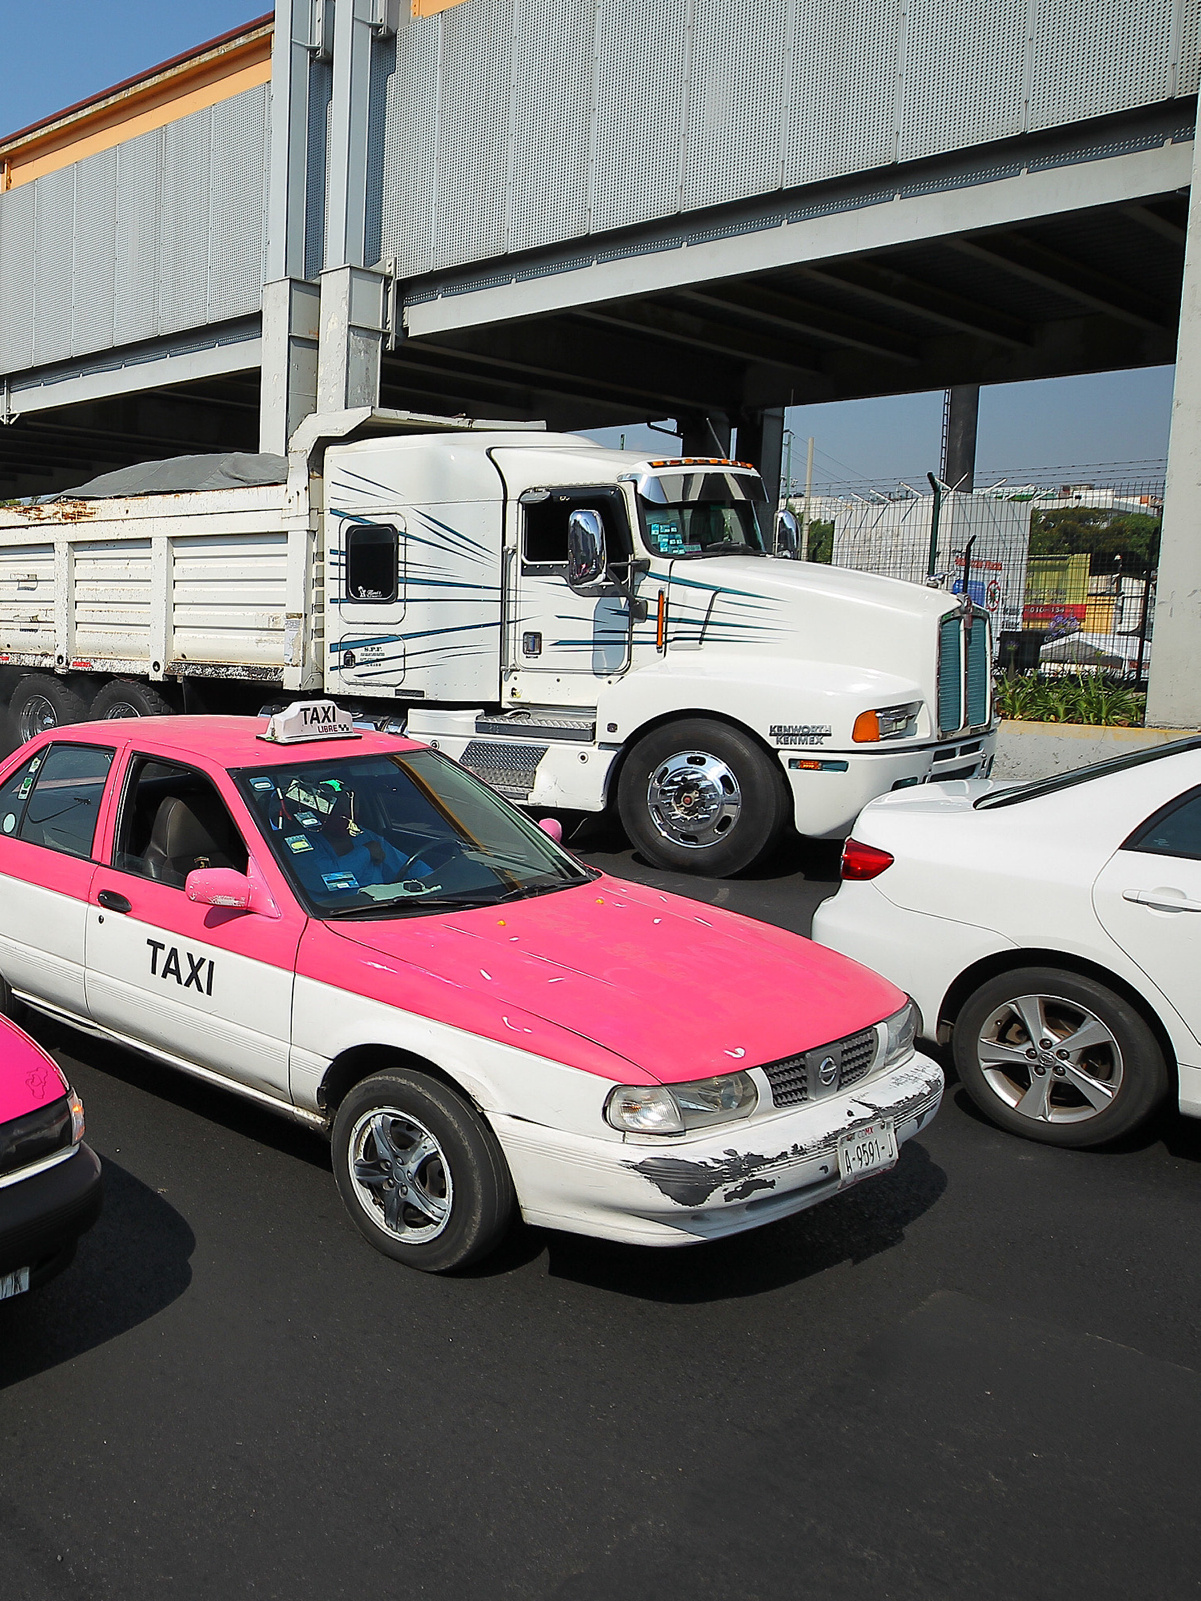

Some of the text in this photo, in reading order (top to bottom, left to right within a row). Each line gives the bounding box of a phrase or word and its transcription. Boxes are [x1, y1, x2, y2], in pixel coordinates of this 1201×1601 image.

[300, 706, 336, 725] TAXI
[317, 724, 338, 733] LIBRE
[769, 725, 831, 734] KENWORTH
[776, 735, 824, 745] KENMEX
[146, 938, 215, 996] TAXI
[844, 1133, 894, 1175] A-9591-J
